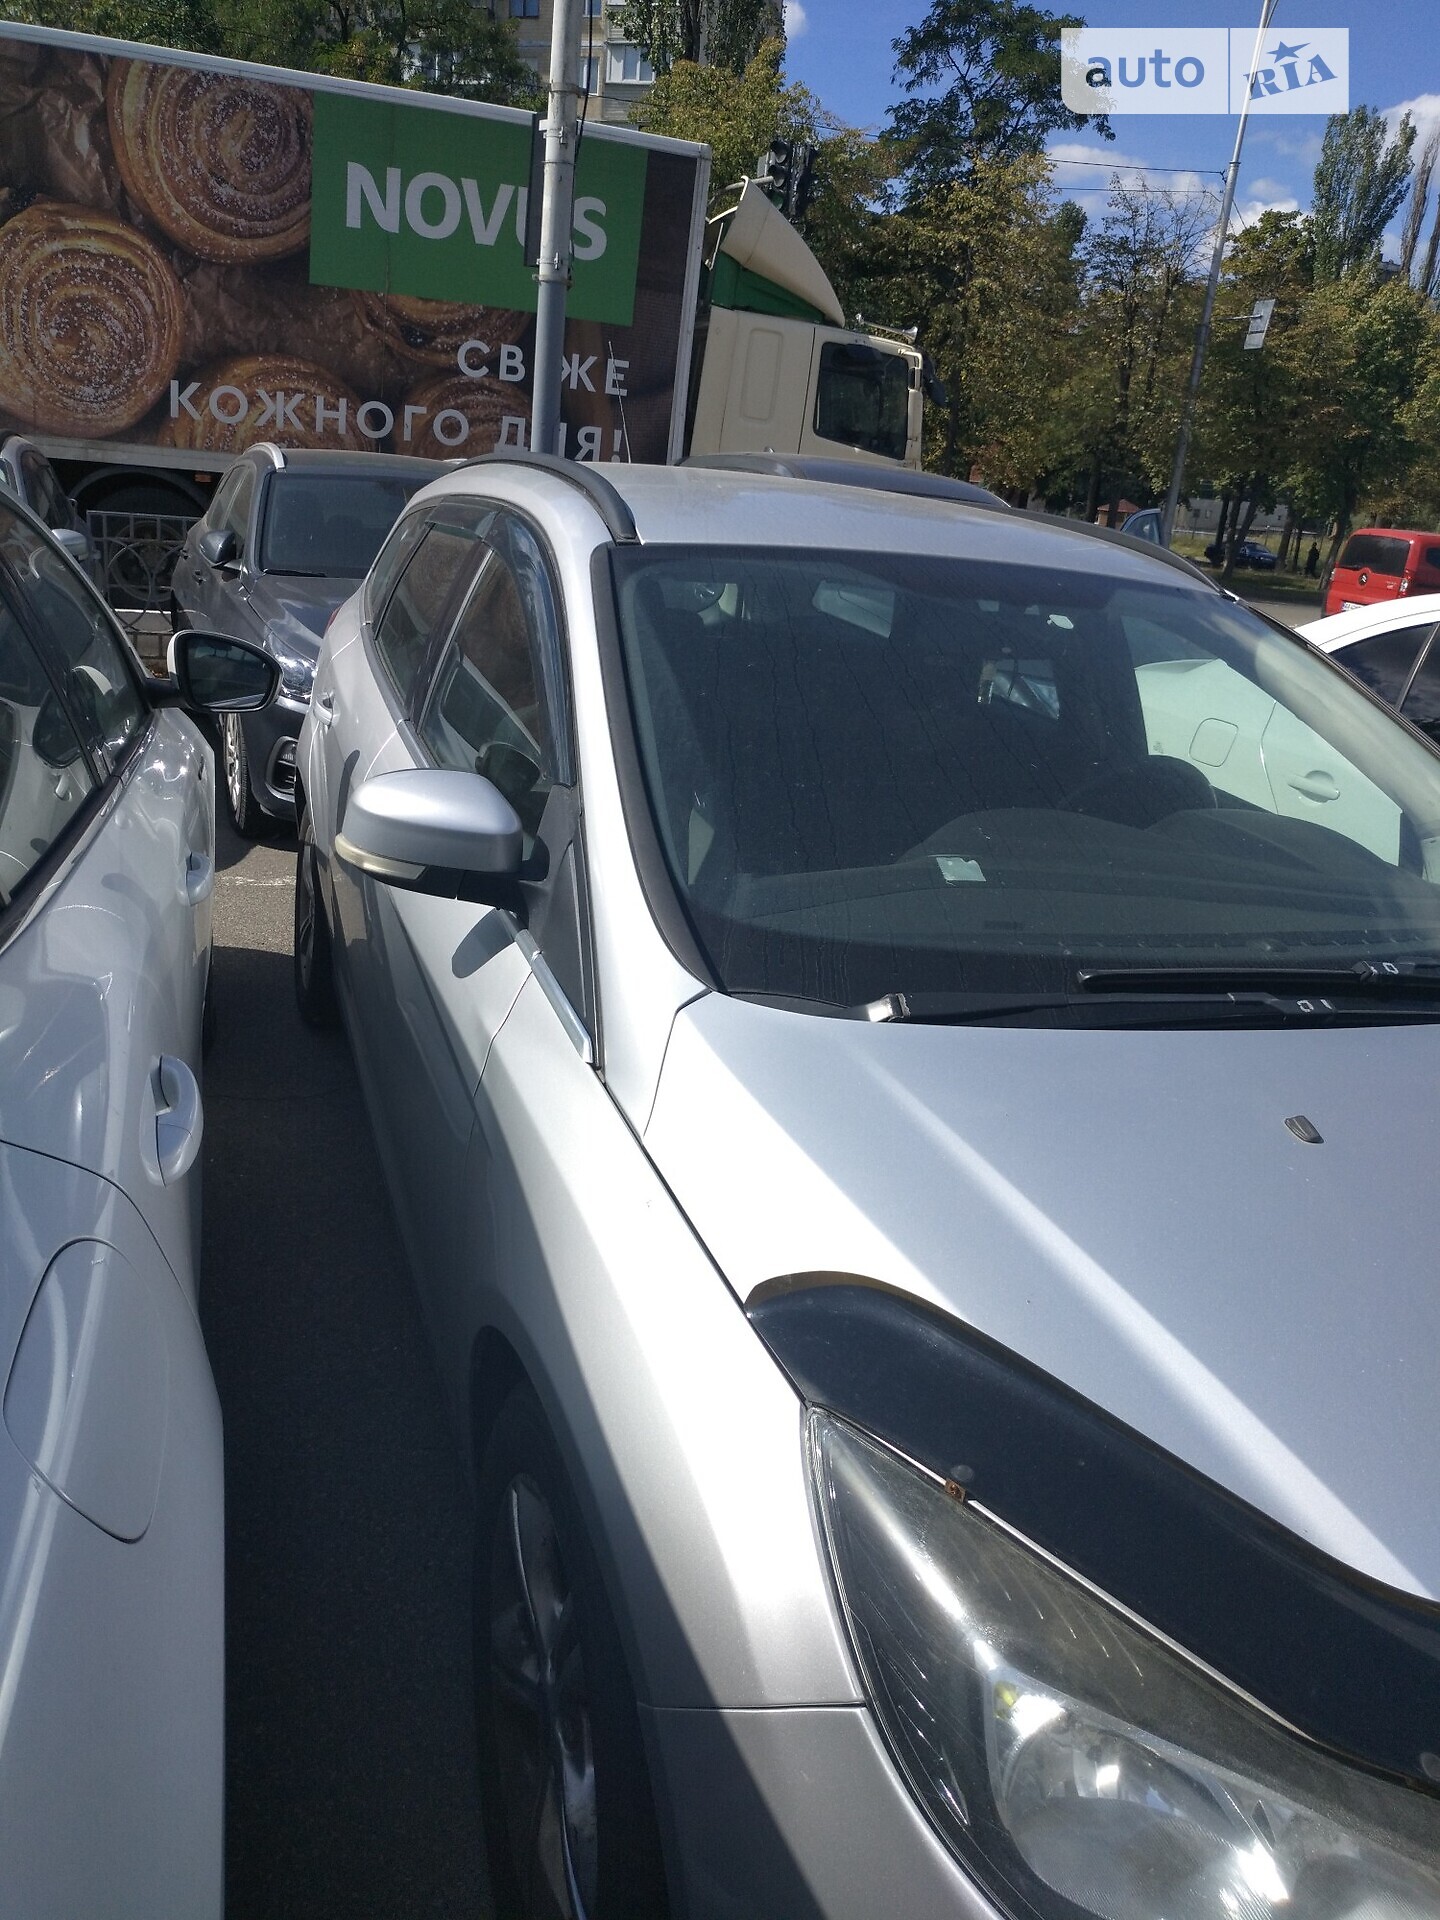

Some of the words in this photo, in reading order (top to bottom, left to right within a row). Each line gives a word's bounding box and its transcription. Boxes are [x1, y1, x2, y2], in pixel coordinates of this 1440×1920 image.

[345, 161, 607, 261] NOVS
[457, 339, 630, 397] СВЖЕ
[169, 379, 470, 447] КОЖНОГО
[493, 415, 623, 463] ДЯ!
